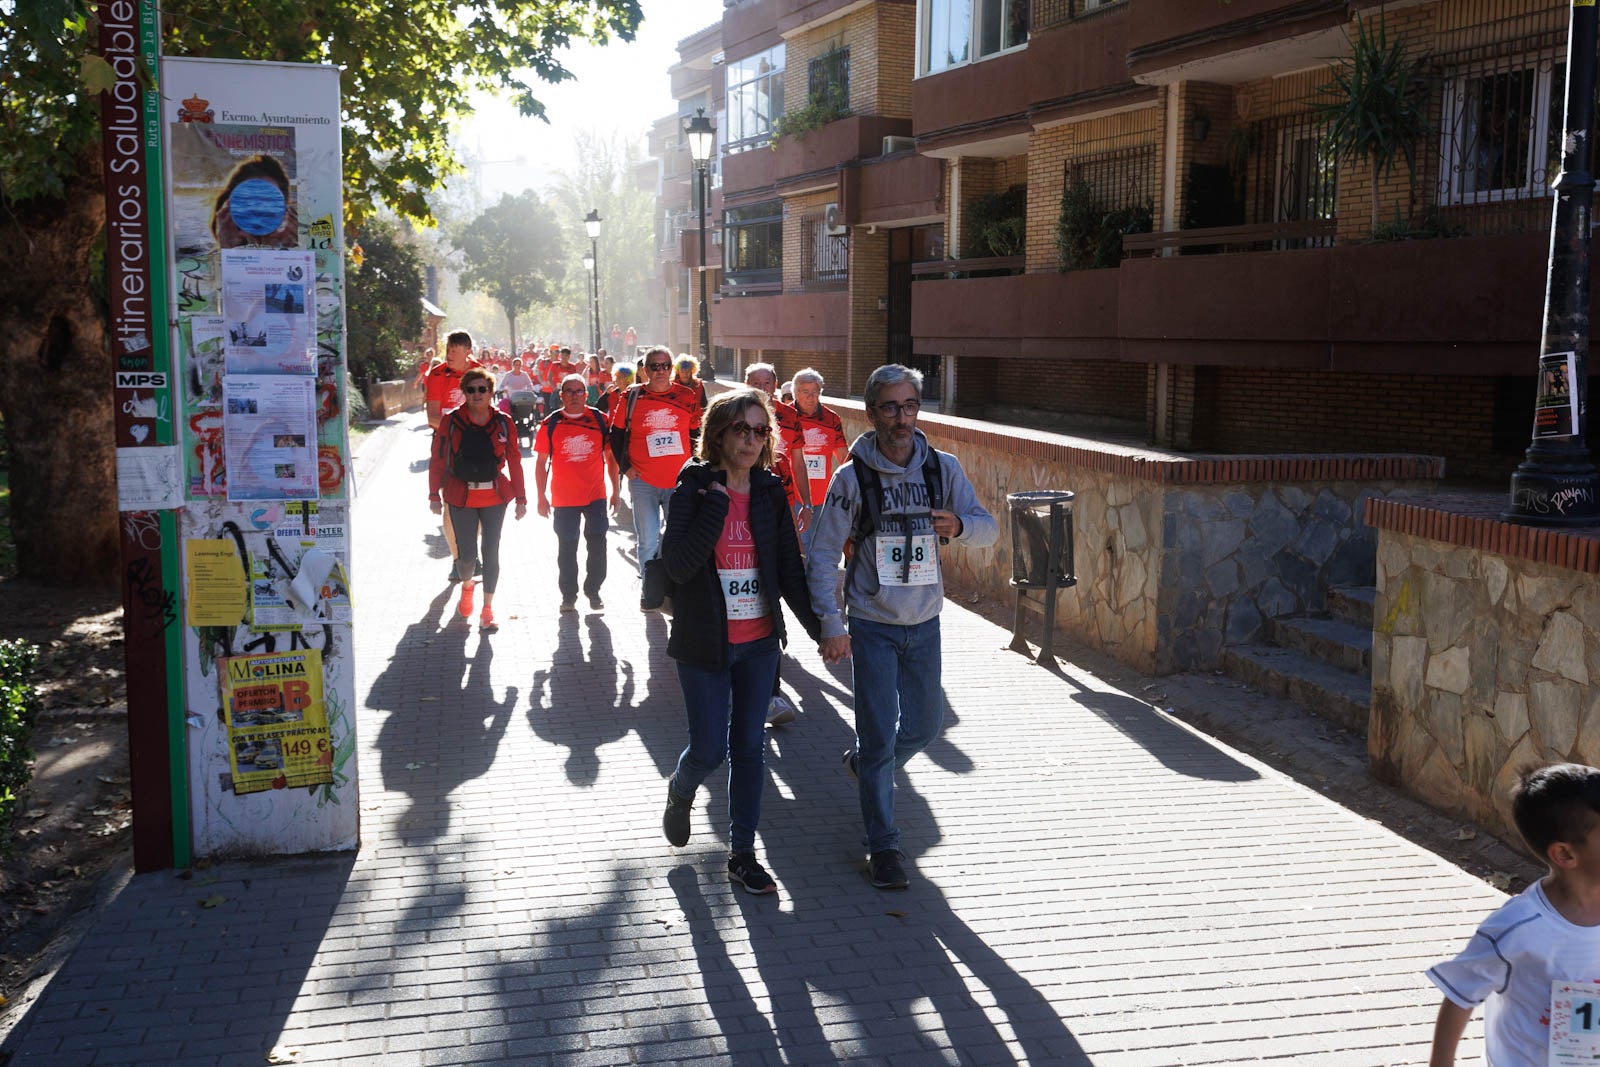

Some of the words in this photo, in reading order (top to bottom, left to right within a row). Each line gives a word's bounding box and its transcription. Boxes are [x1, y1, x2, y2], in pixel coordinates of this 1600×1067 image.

[143, 31, 156, 45] la
[145, 51, 157, 66] de
[221, 109, 258, 123] Excmo.
[260, 111, 332, 128] Ayuntamiento
[147, 120, 159, 148] Ruta
[118, 374, 166, 386] MPS
[655, 436, 673, 446] 372
[276, 528, 301, 537] OFERTA
[891, 547, 924, 562] 88
[729, 579, 760, 596] 849
[250, 655, 306, 666] AUTOESCUELAS
[234, 661, 306, 680] MOLINA
[237, 697, 277, 708] PERMISO
[232, 735, 247, 744] CON
[257, 731, 285, 741] CLASES
[283, 739, 311, 757] 149
[317, 738, 330, 754] €
[1575, 1002, 1600, 1030] 1
